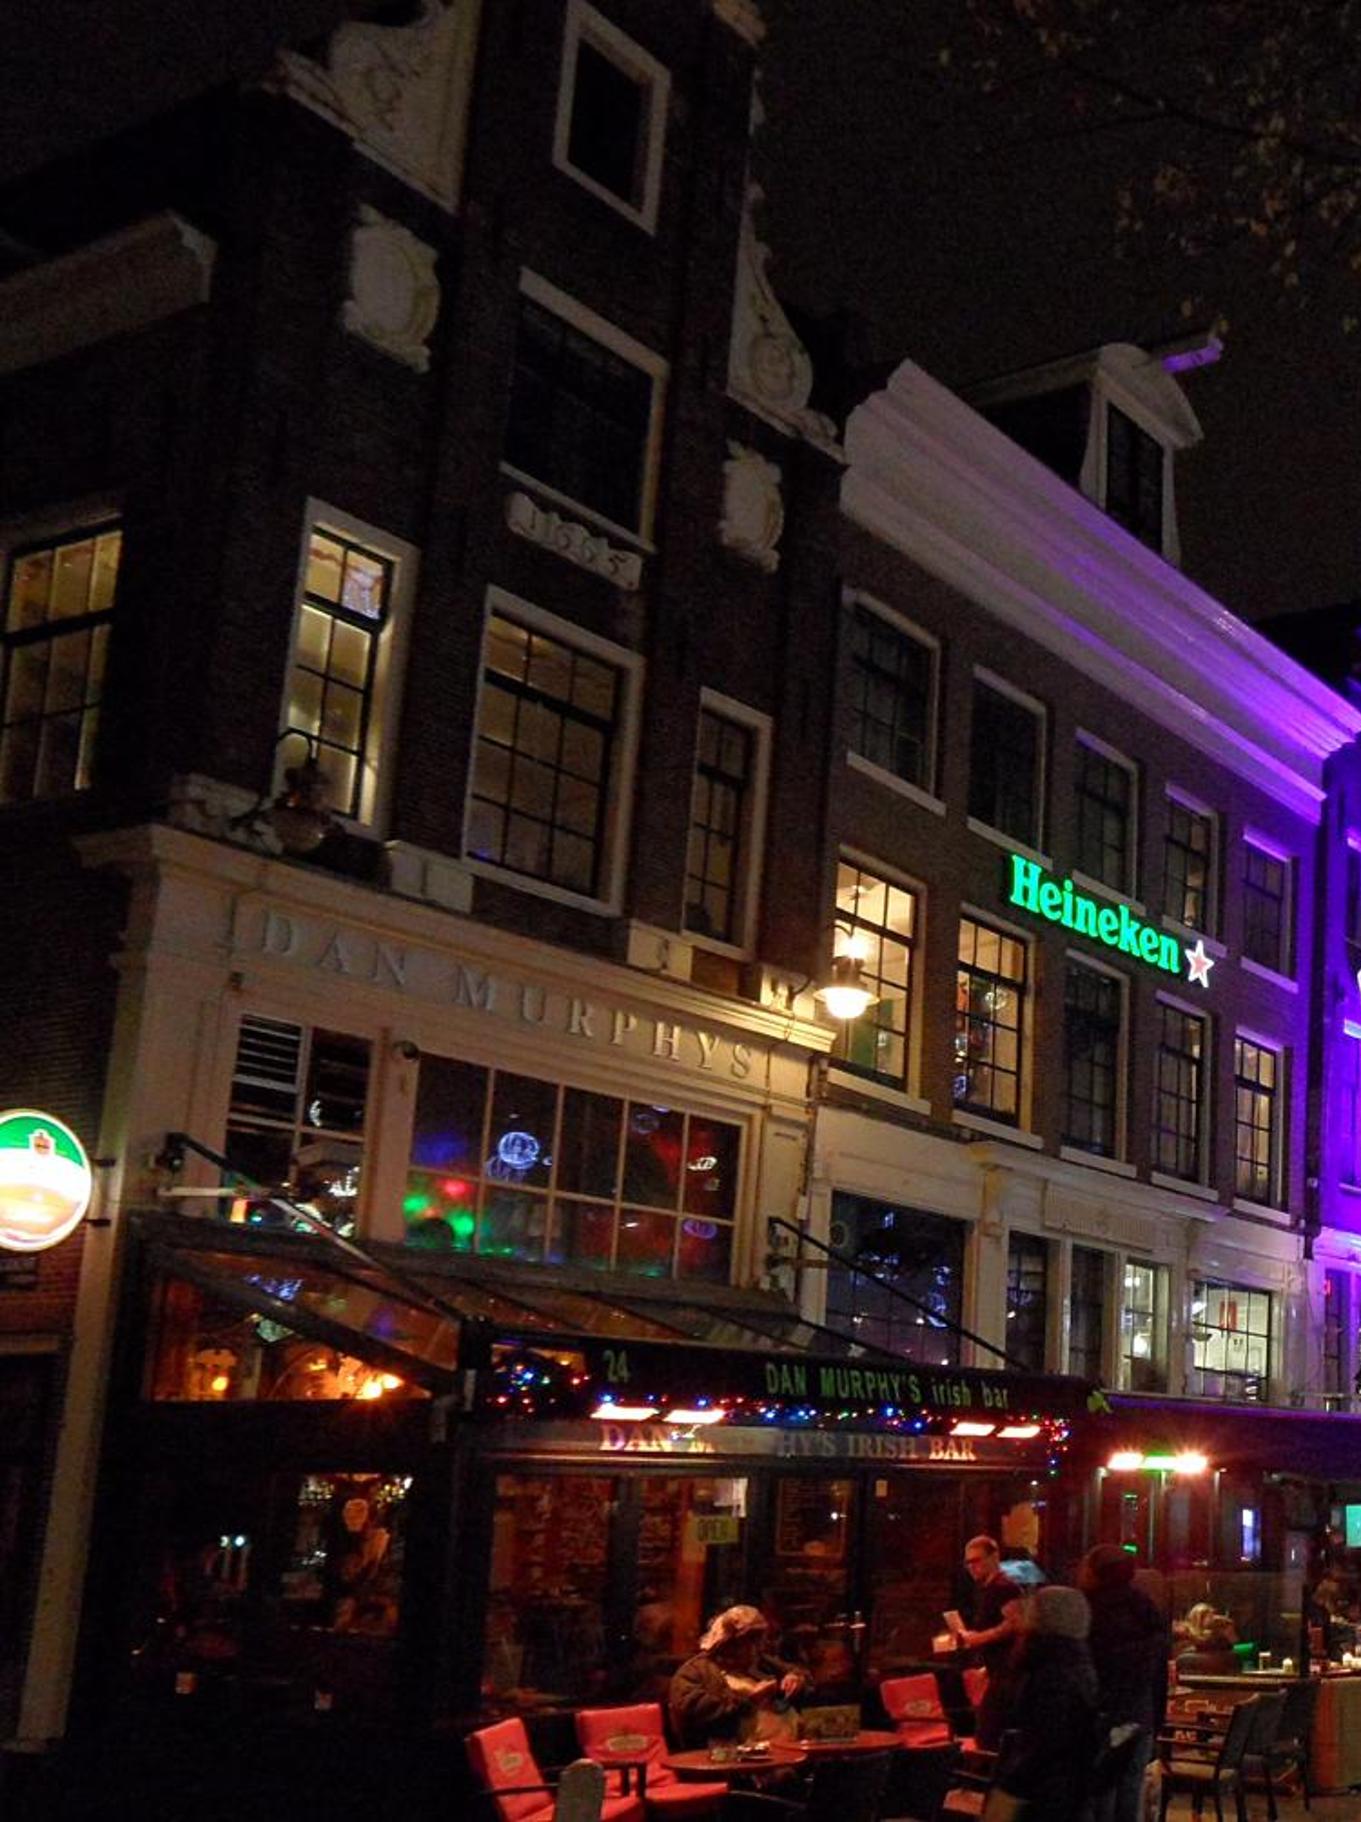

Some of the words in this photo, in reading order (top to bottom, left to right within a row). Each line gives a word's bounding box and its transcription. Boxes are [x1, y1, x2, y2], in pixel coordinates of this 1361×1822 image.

[1010, 854, 1181, 974] Heineken
[262, 911, 408, 987] DAN
[454, 963, 751, 1079] MURPHYS
[602, 1349, 631, 1383] 24
[766, 1362, 807, 1396] DAN
[820, 1366, 922, 1405] MURPHY'S
[931, 1377, 972, 1408] irish
[981, 1379, 1009, 1409] bar
[600, 1424, 673, 1452] DAN
[847, 1432, 919, 1459] IRISH
[929, 1437, 978, 1461] BAR
